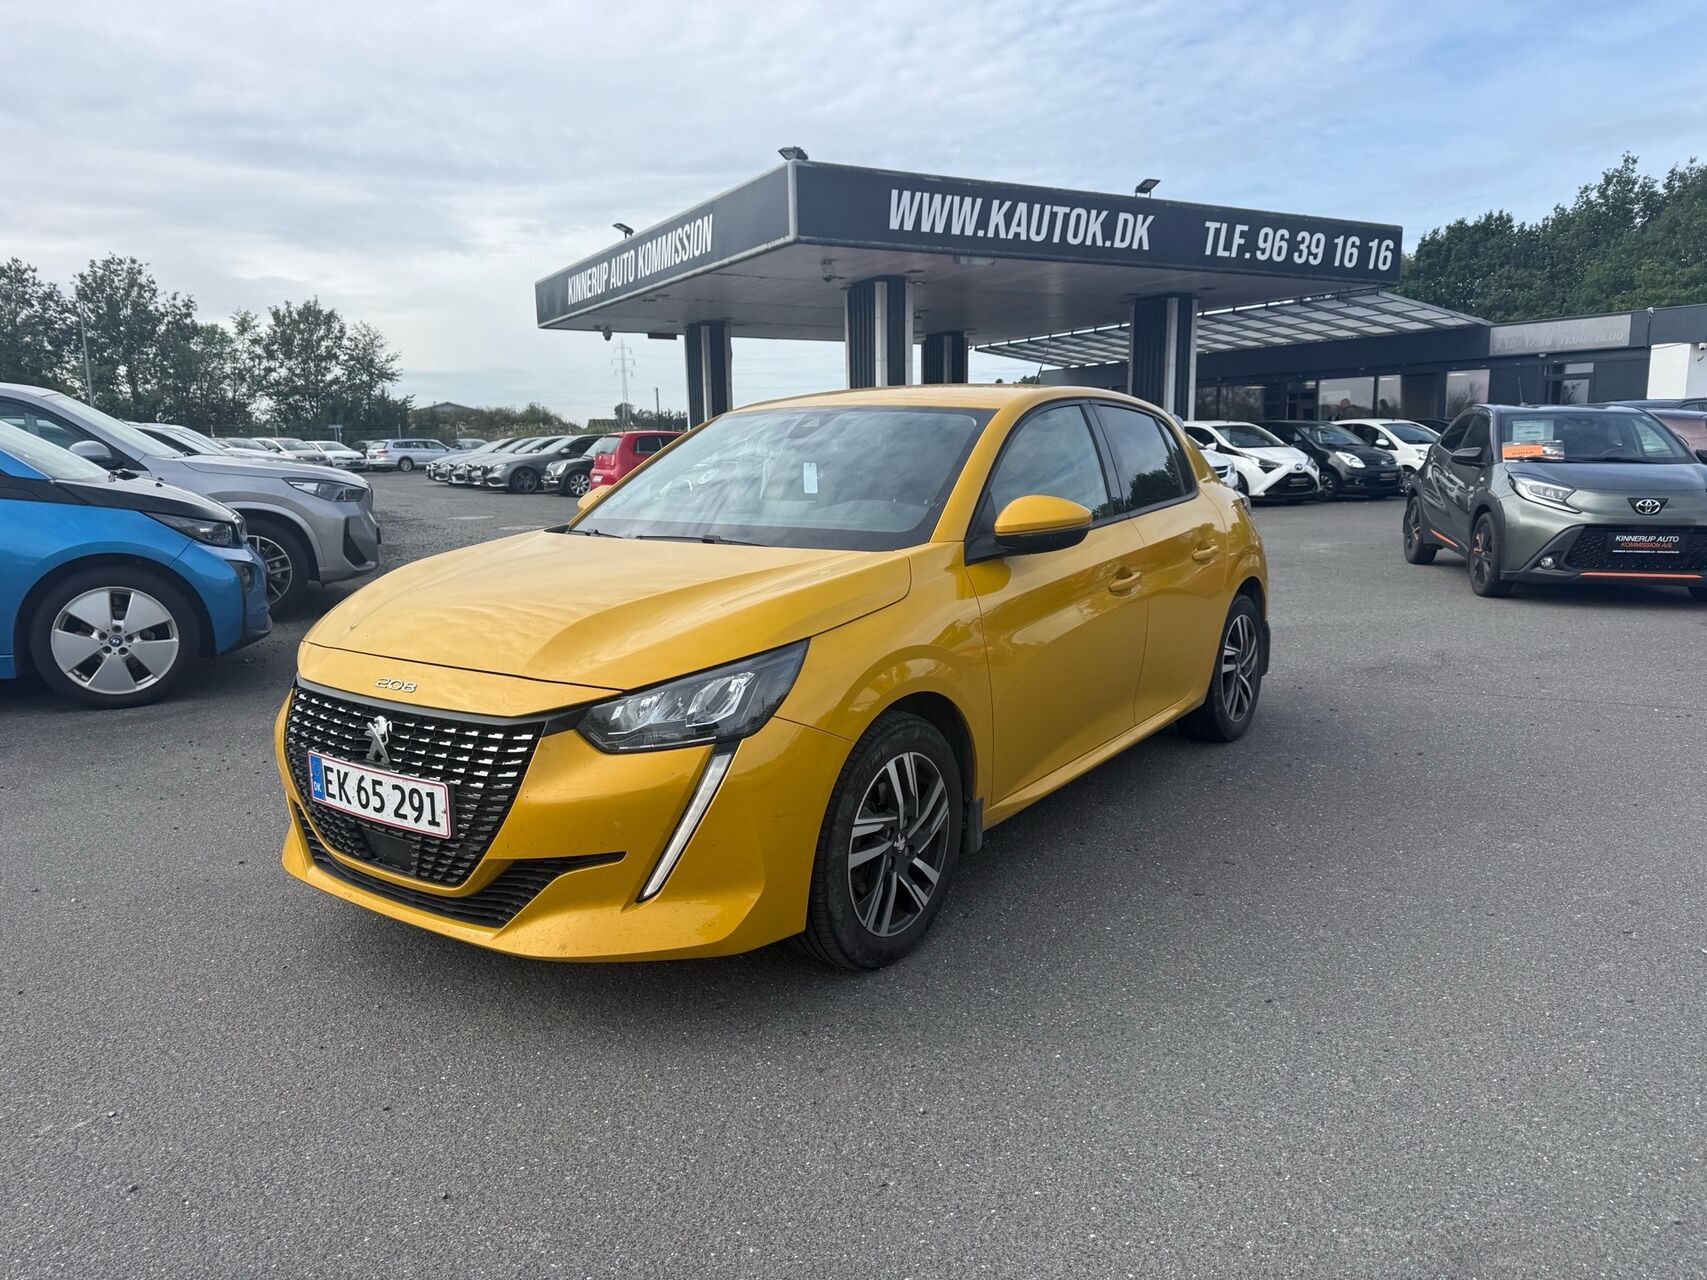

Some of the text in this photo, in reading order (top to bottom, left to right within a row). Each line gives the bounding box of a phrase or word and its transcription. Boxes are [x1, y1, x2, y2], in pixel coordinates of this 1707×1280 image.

[888, 188, 1155, 250] WWW.KAUTOK.DK
[1204, 221, 1395, 272] TLF. 96 39 16 16
[568, 213, 713, 306] KINNERUP AUTO KOMMISSION
[375, 678, 418, 693] 208
[313, 781, 322, 793] DK
[323, 764, 441, 828] EK 65 291
